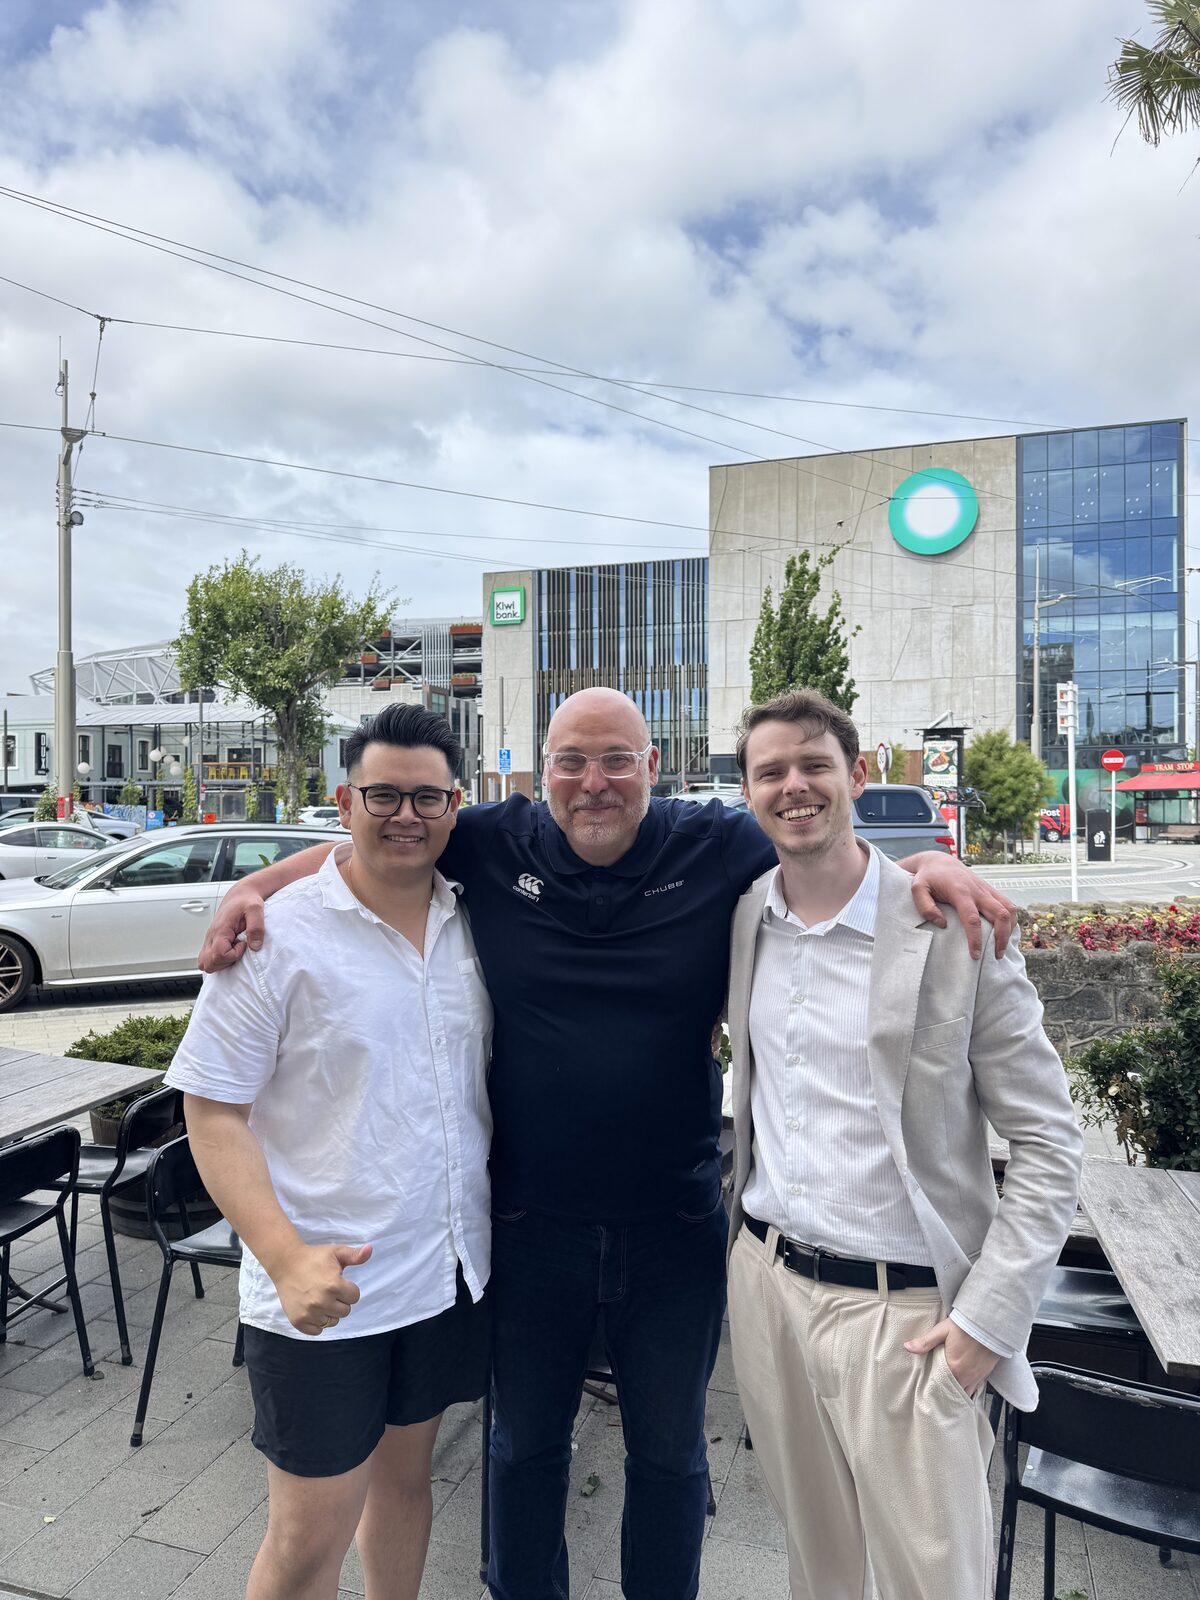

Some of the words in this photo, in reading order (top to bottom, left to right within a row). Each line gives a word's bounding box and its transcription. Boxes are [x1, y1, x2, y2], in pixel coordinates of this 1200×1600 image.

[495, 600, 515, 611] Kiwi
[1176, 762, 1195, 770] STOP
[1040, 808, 1061, 817] Post
